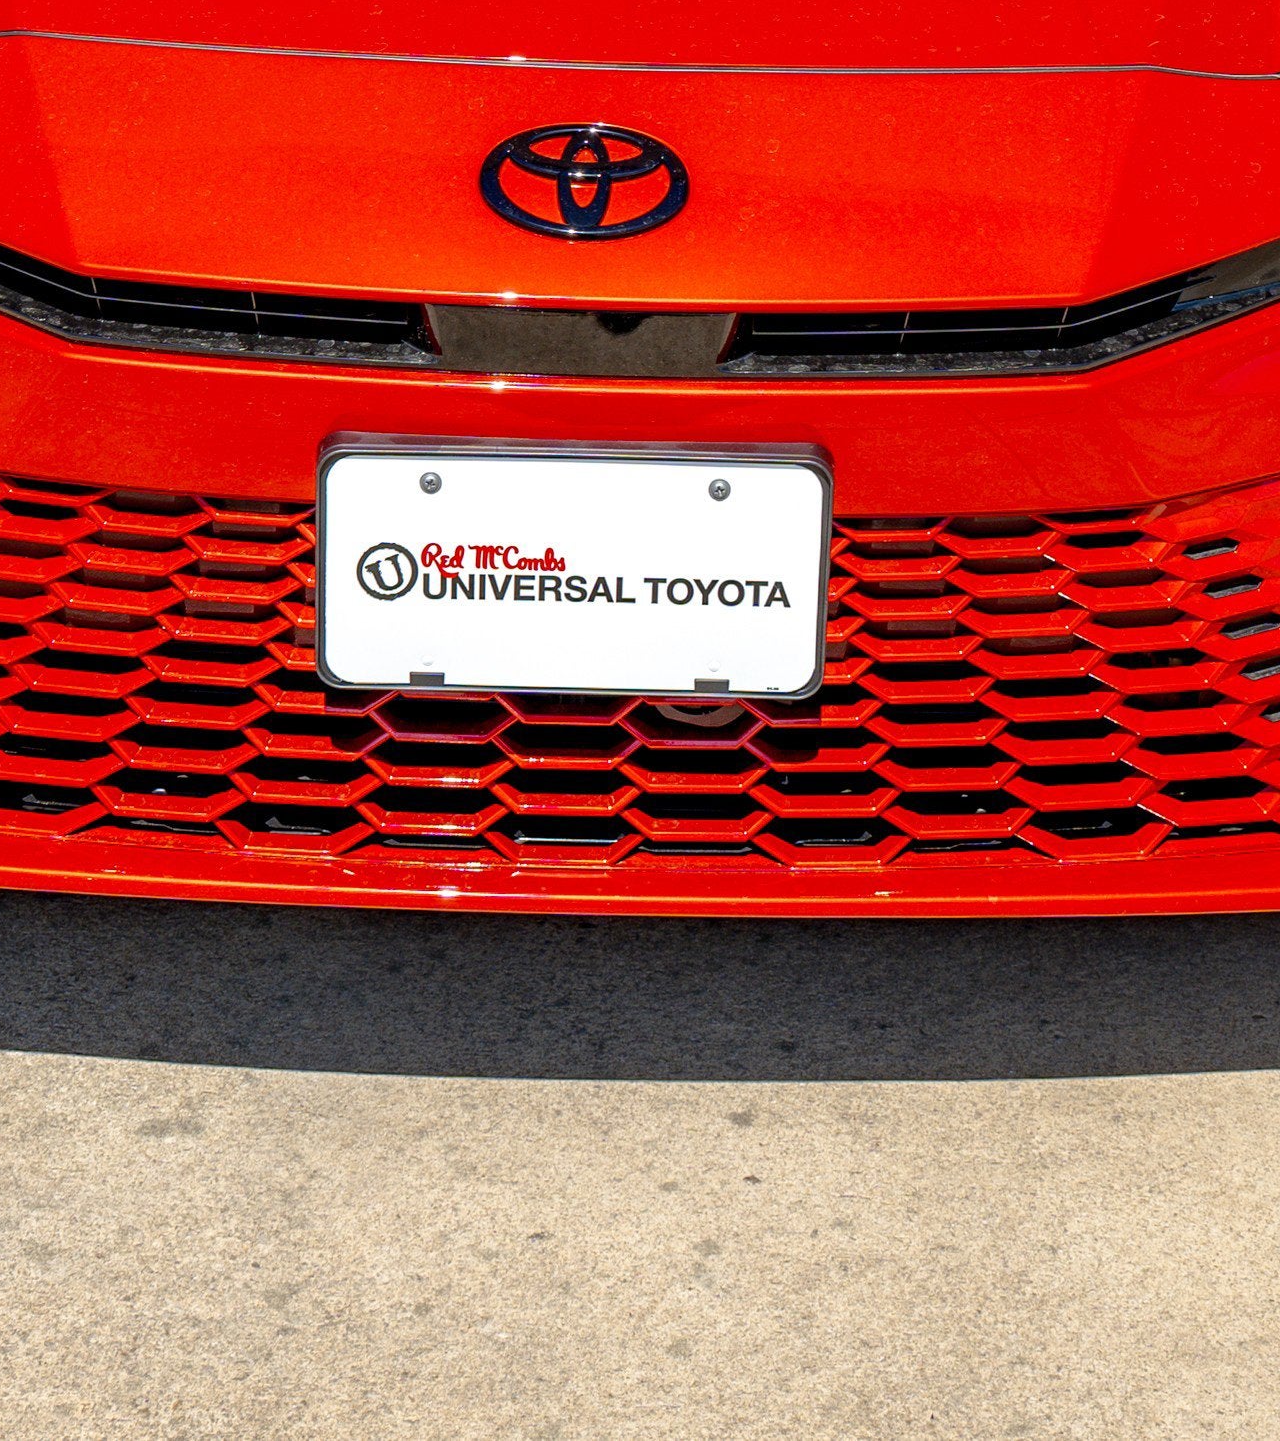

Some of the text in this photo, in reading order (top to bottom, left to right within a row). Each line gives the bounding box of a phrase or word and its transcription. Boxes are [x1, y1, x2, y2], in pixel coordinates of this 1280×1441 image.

[421, 542, 566, 579] Red McCombs
[422, 572, 792, 609] UNIVERSAL TOYOTA
